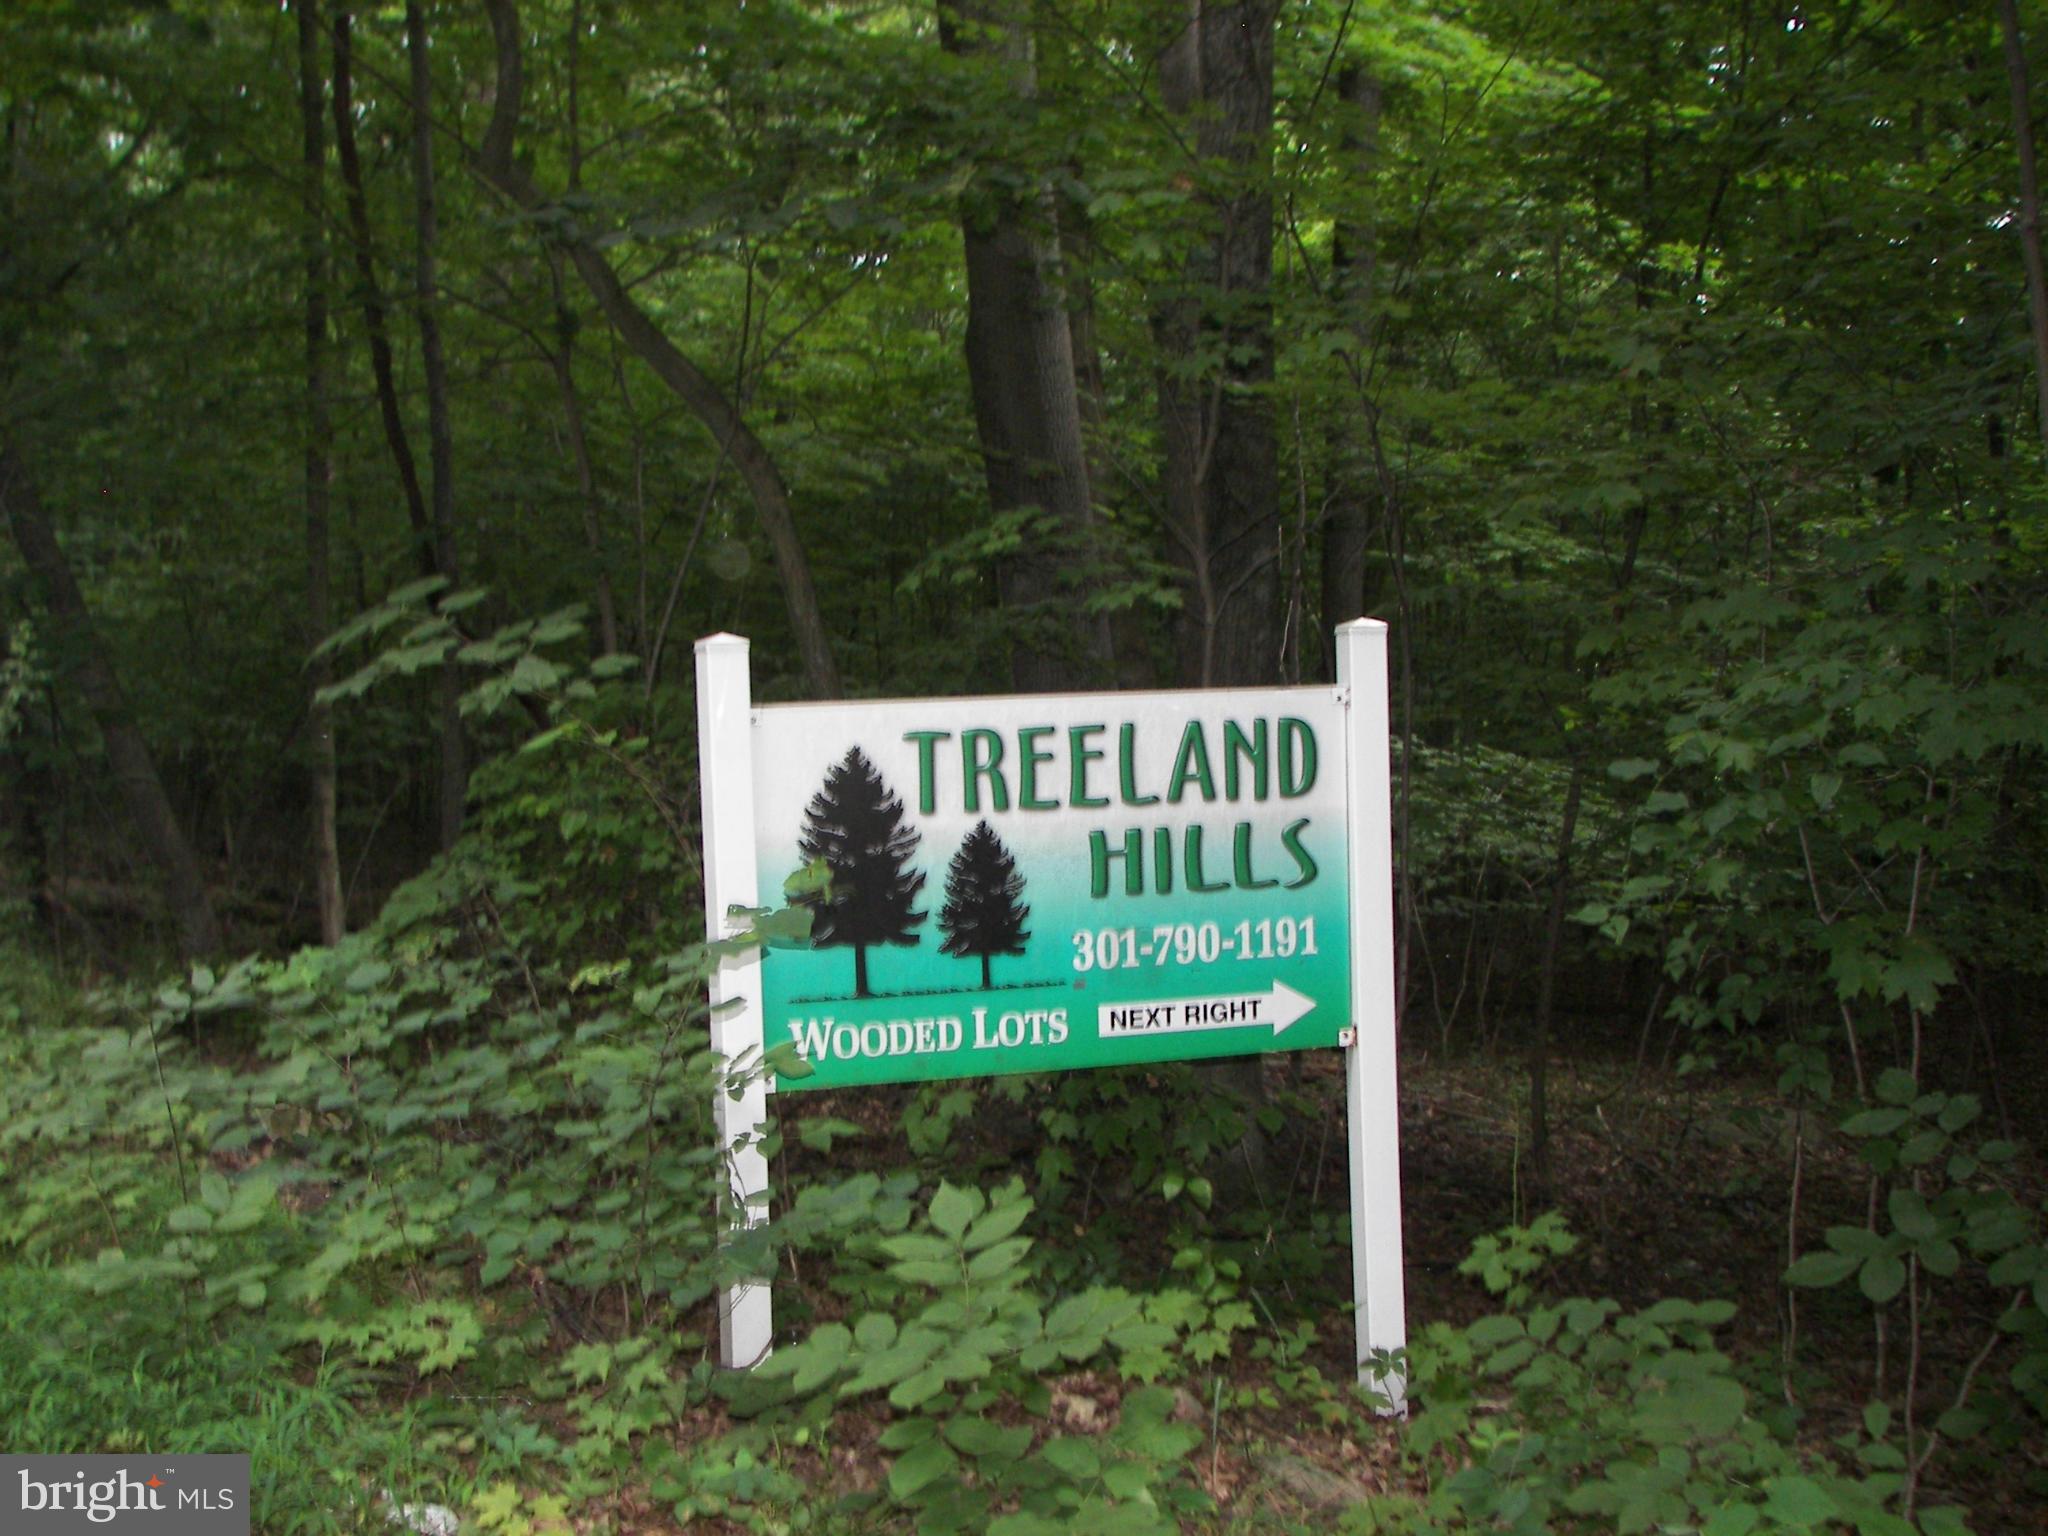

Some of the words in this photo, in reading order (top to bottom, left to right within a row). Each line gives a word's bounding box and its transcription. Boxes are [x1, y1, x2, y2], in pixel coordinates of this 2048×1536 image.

[902, 717, 1319, 815] TREELAND
[1088, 818, 1319, 899] HILLS
[1072, 915, 1319, 972] 301-790-1191
[1109, 1006, 1176, 1032] NEXT
[1184, 999, 1263, 1026] RIGHT
